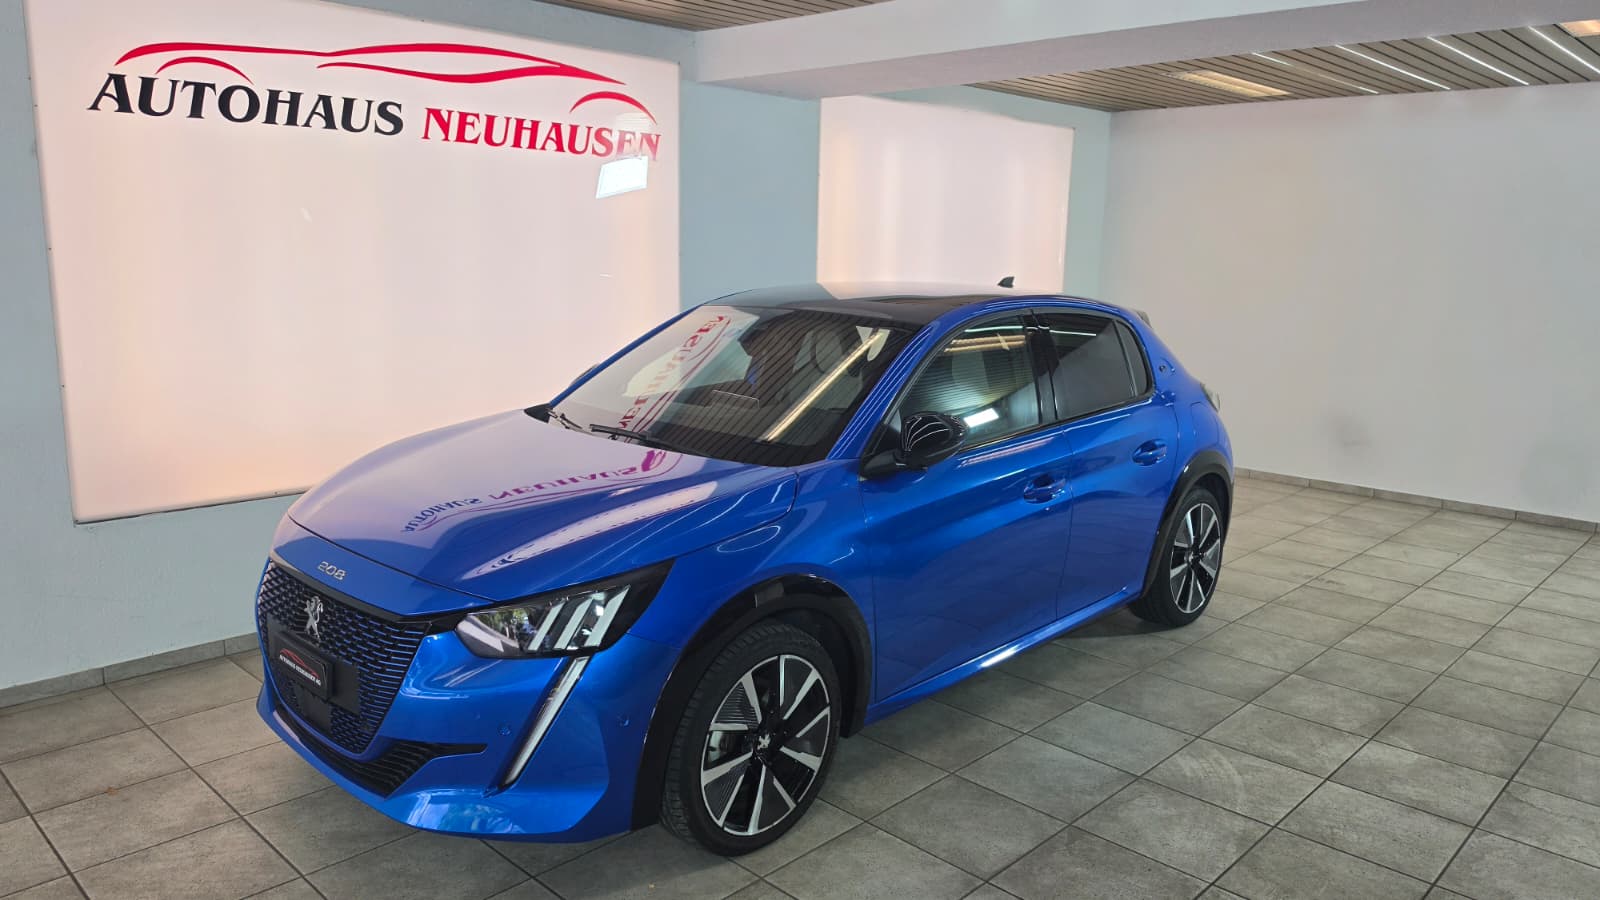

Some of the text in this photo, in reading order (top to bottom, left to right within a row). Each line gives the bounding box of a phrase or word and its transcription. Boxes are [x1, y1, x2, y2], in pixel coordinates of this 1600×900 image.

[87, 73, 662, 162] AUTOHAUS NEUHAUSEN
[317, 561, 347, 581] 208
